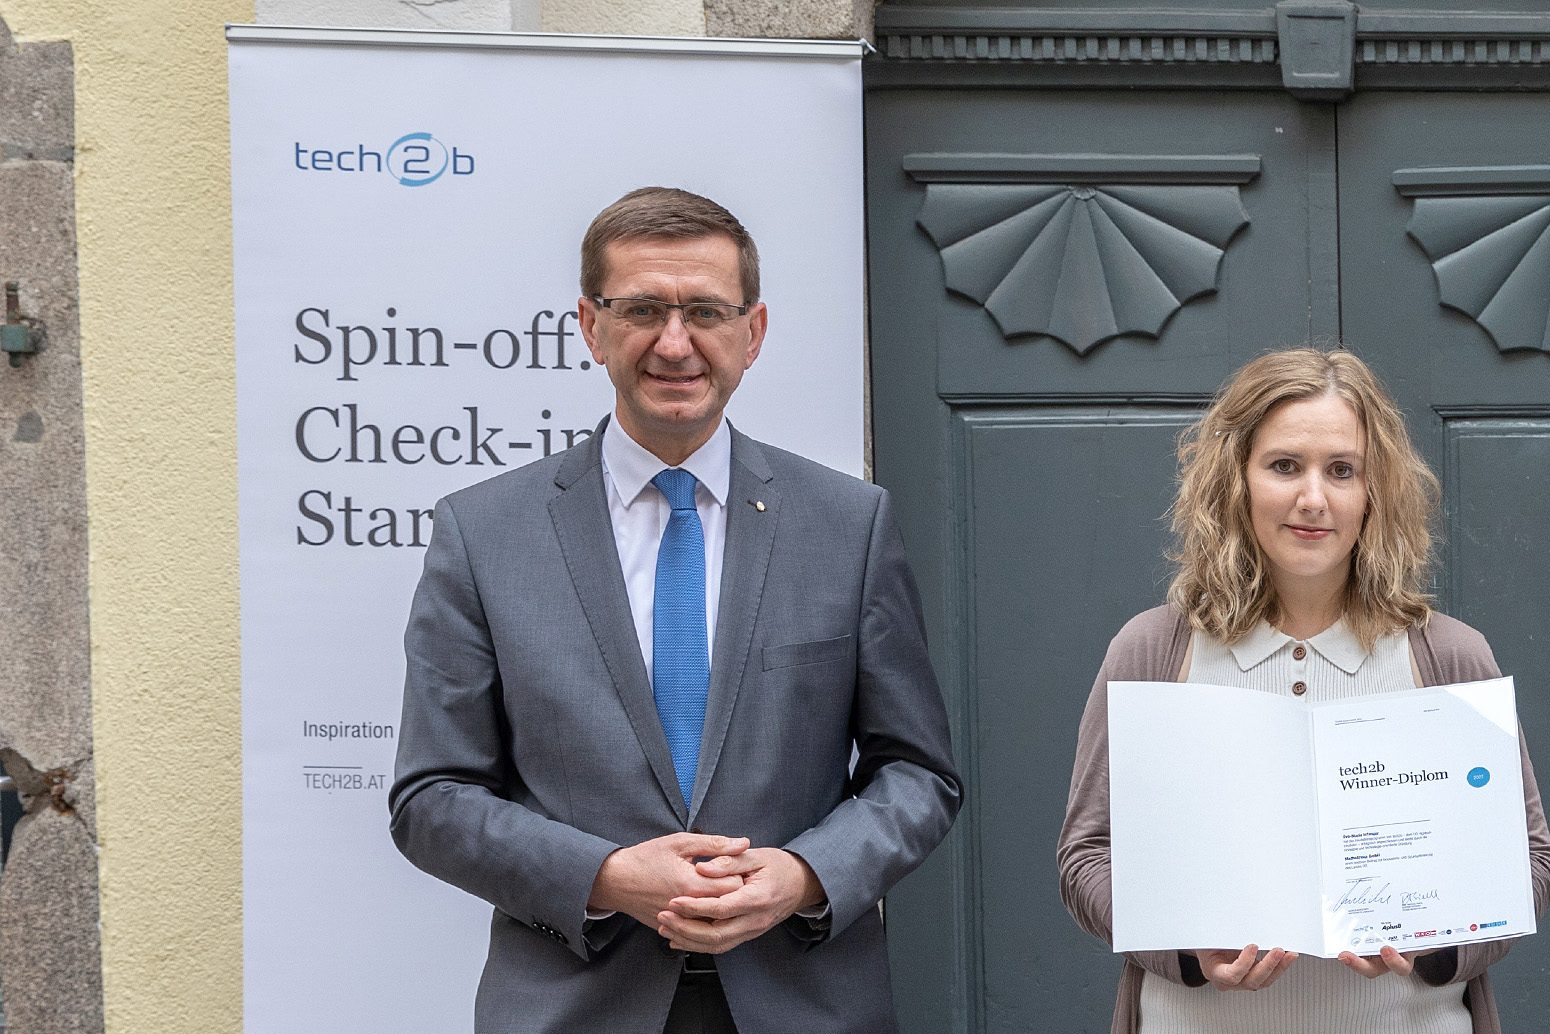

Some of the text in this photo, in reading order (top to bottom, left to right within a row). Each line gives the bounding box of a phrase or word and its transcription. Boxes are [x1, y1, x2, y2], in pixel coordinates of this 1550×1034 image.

[295, 141, 475, 177] tech2b
[294, 307, 592, 382] Spin-off.
[303, 720, 394, 741] Inspiration
[1339, 760, 1385, 777] tech2b
[303, 772, 387, 790] TECH2B.AT
[1339, 769, 1449, 791] Winner-Diplom
